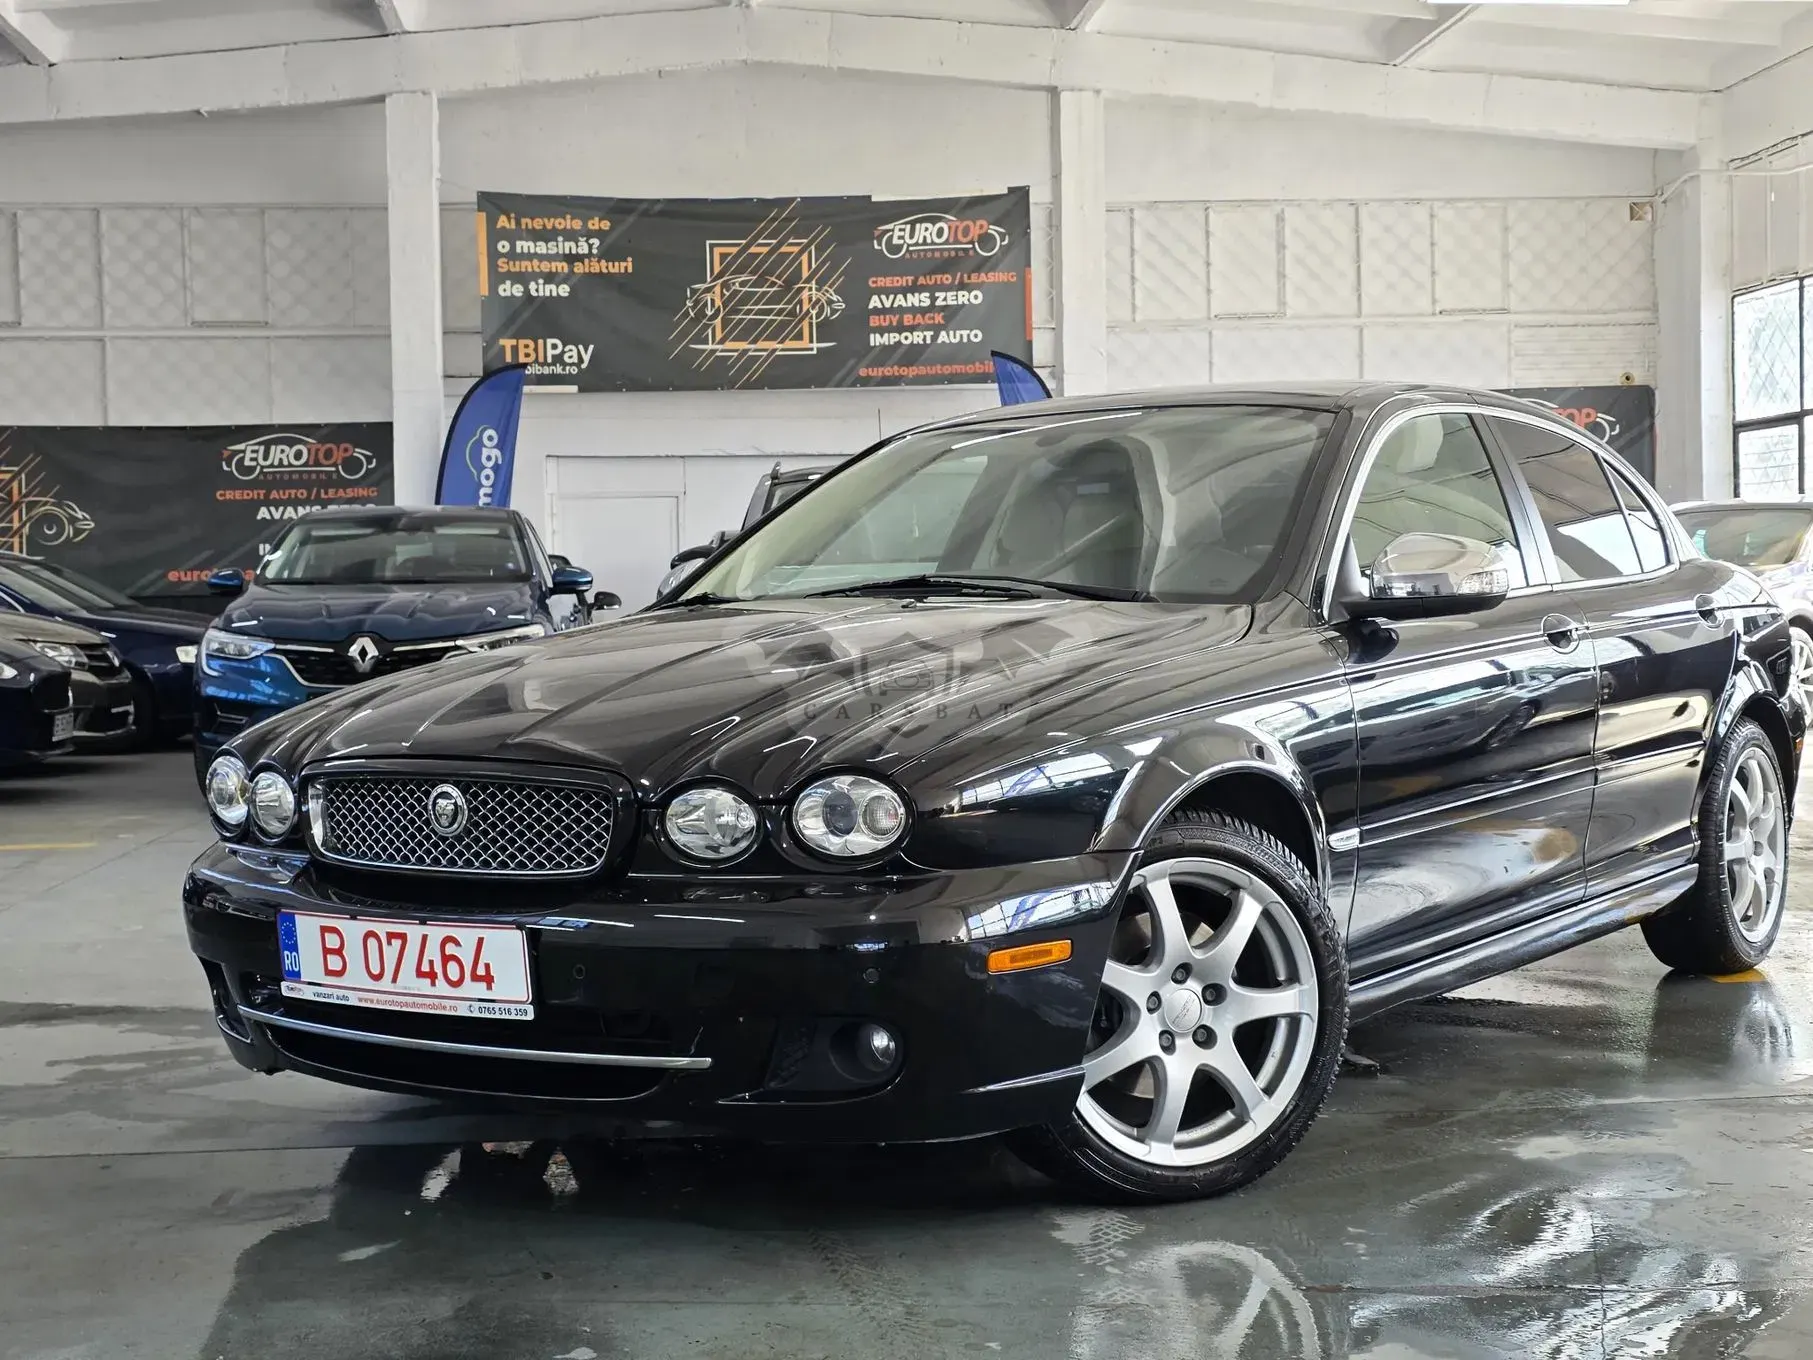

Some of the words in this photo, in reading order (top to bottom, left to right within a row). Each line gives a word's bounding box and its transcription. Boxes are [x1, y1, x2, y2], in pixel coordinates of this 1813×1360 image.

[496, 213, 516, 229] Ai
[521, 214, 583, 230] nevoie
[588, 217, 611, 230] de
[892, 219, 989, 244] EUROTOP
[497, 240, 510, 253] o
[497, 257, 568, 273] Suntem
[573, 256, 633, 274] alături
[498, 280, 524, 297] de
[529, 278, 570, 297] tine
[868, 276, 914, 287] CREDIT
[917, 274, 952, 285] AUTO
[964, 271, 1017, 283] LEASING
[868, 291, 930, 309] AVANS
[935, 290, 984, 306] ZERO
[869, 314, 899, 327] BUY
[903, 312, 945, 326] BACK
[869, 330, 934, 346] IMPORT
[937, 329, 983, 344] AUTO
[858, 360, 994, 378] eurotopautomobil
[244, 443, 354, 466] EUROTOP
[216, 489, 266, 500] CREDIT
[269, 488, 307, 499] AUTO
[321, 487, 378, 499] LEASING
[284, 951, 299, 972] RO
[319, 924, 348, 978] B
[362, 929, 495, 991] 07464
[312, 991, 335, 1000] vanzari
[336, 994, 350, 1002] auto
[357, 996, 458, 1013] www.eurotopautomobile.ro
[478, 1006, 497, 1016] 0765
[498, 1006, 512, 1016] 516
[514, 1007, 528, 1017] 359
